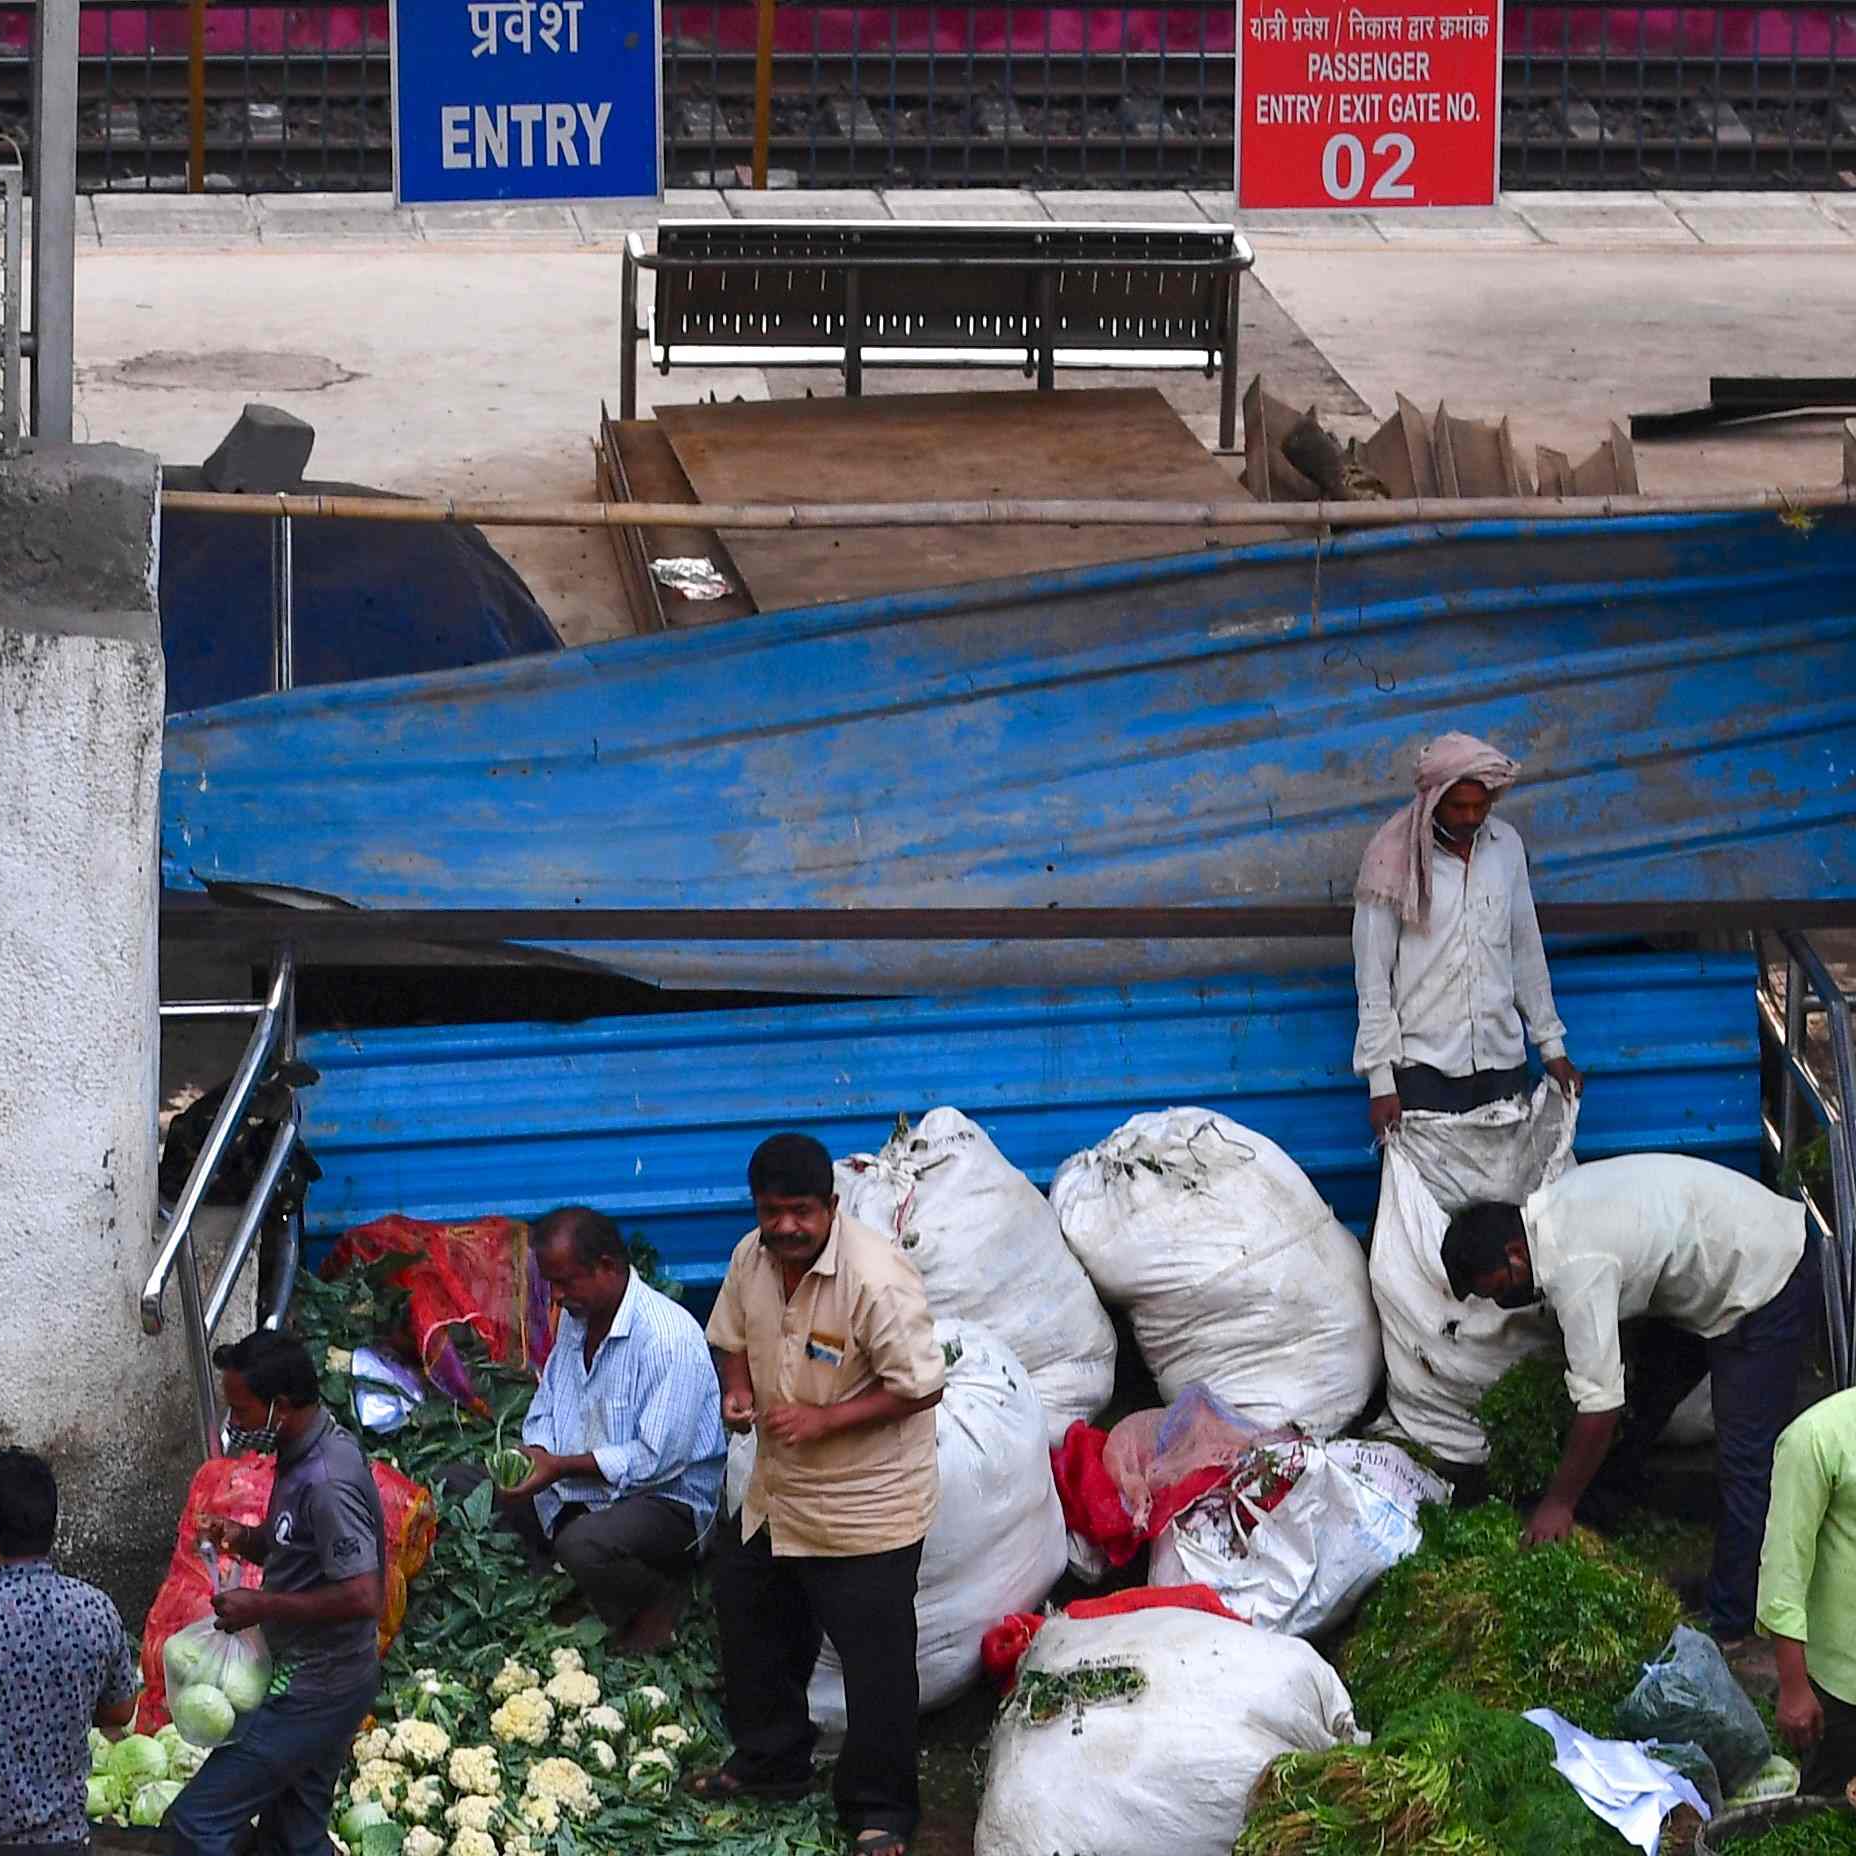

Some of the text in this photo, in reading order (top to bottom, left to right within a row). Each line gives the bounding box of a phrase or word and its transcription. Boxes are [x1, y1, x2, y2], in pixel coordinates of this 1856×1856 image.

[467, 0, 584, 58] प्रवेश
[1293, 8, 1330, 42] प्रवेश
[1334, 11, 1342, 48] /
[1348, 8, 1402, 41] निकास
[1407, 15, 1434, 41] द्वार
[1439, 8, 1490, 40] क्रमांक
[1307, 51, 1430, 82] PASSENGER
[1256, 92, 1481, 124] ENTRY / EXIT GATE NO.
[441, 102, 613, 169] ENTRY
[1321, 132, 1416, 201] 02
